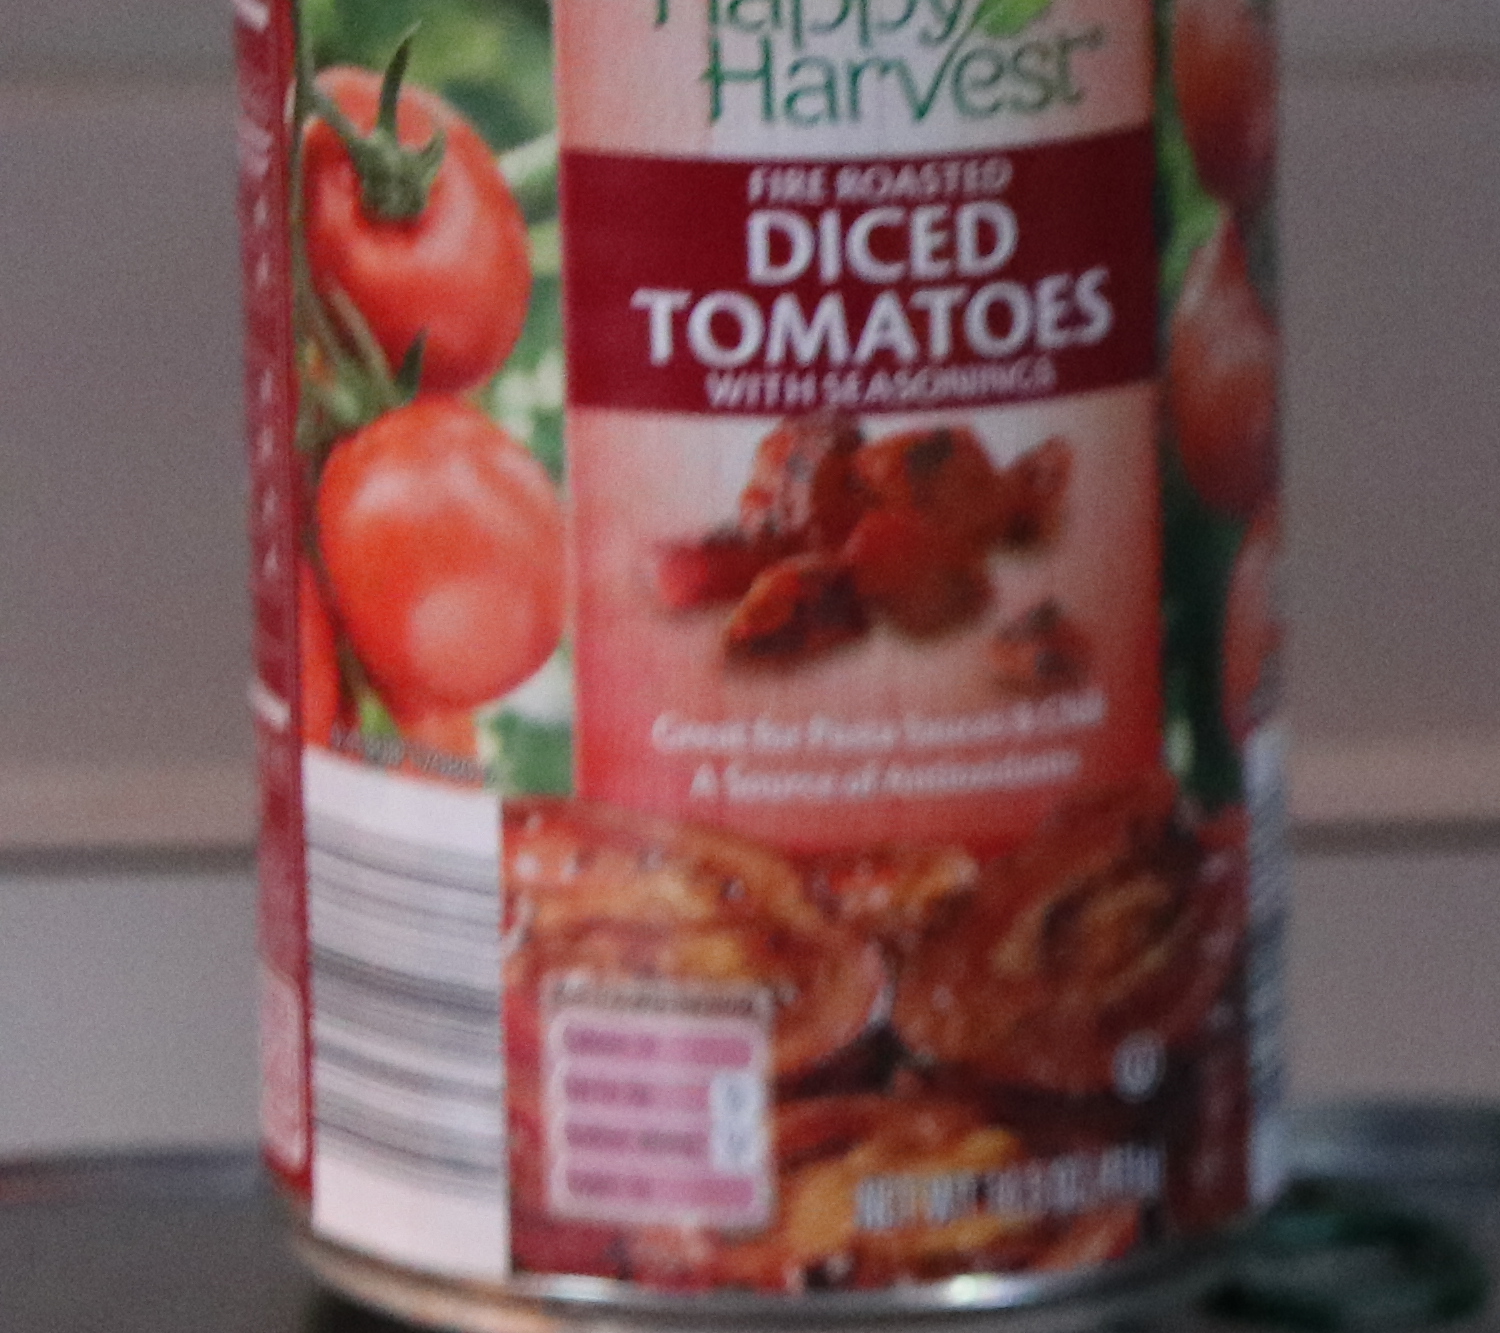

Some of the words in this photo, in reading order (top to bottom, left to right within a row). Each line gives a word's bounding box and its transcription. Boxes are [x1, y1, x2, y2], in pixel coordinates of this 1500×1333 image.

[701, 27, 1101, 126] Harvest
[748, 166, 827, 204] FIRE
[835, 157, 1013, 202] ROASTED
[747, 200, 1018, 286] DICED
[631, 267, 1113, 367] TOMATOES
[705, 369, 817, 408] WITH
[823, 355, 1057, 406] SEASONINGS
